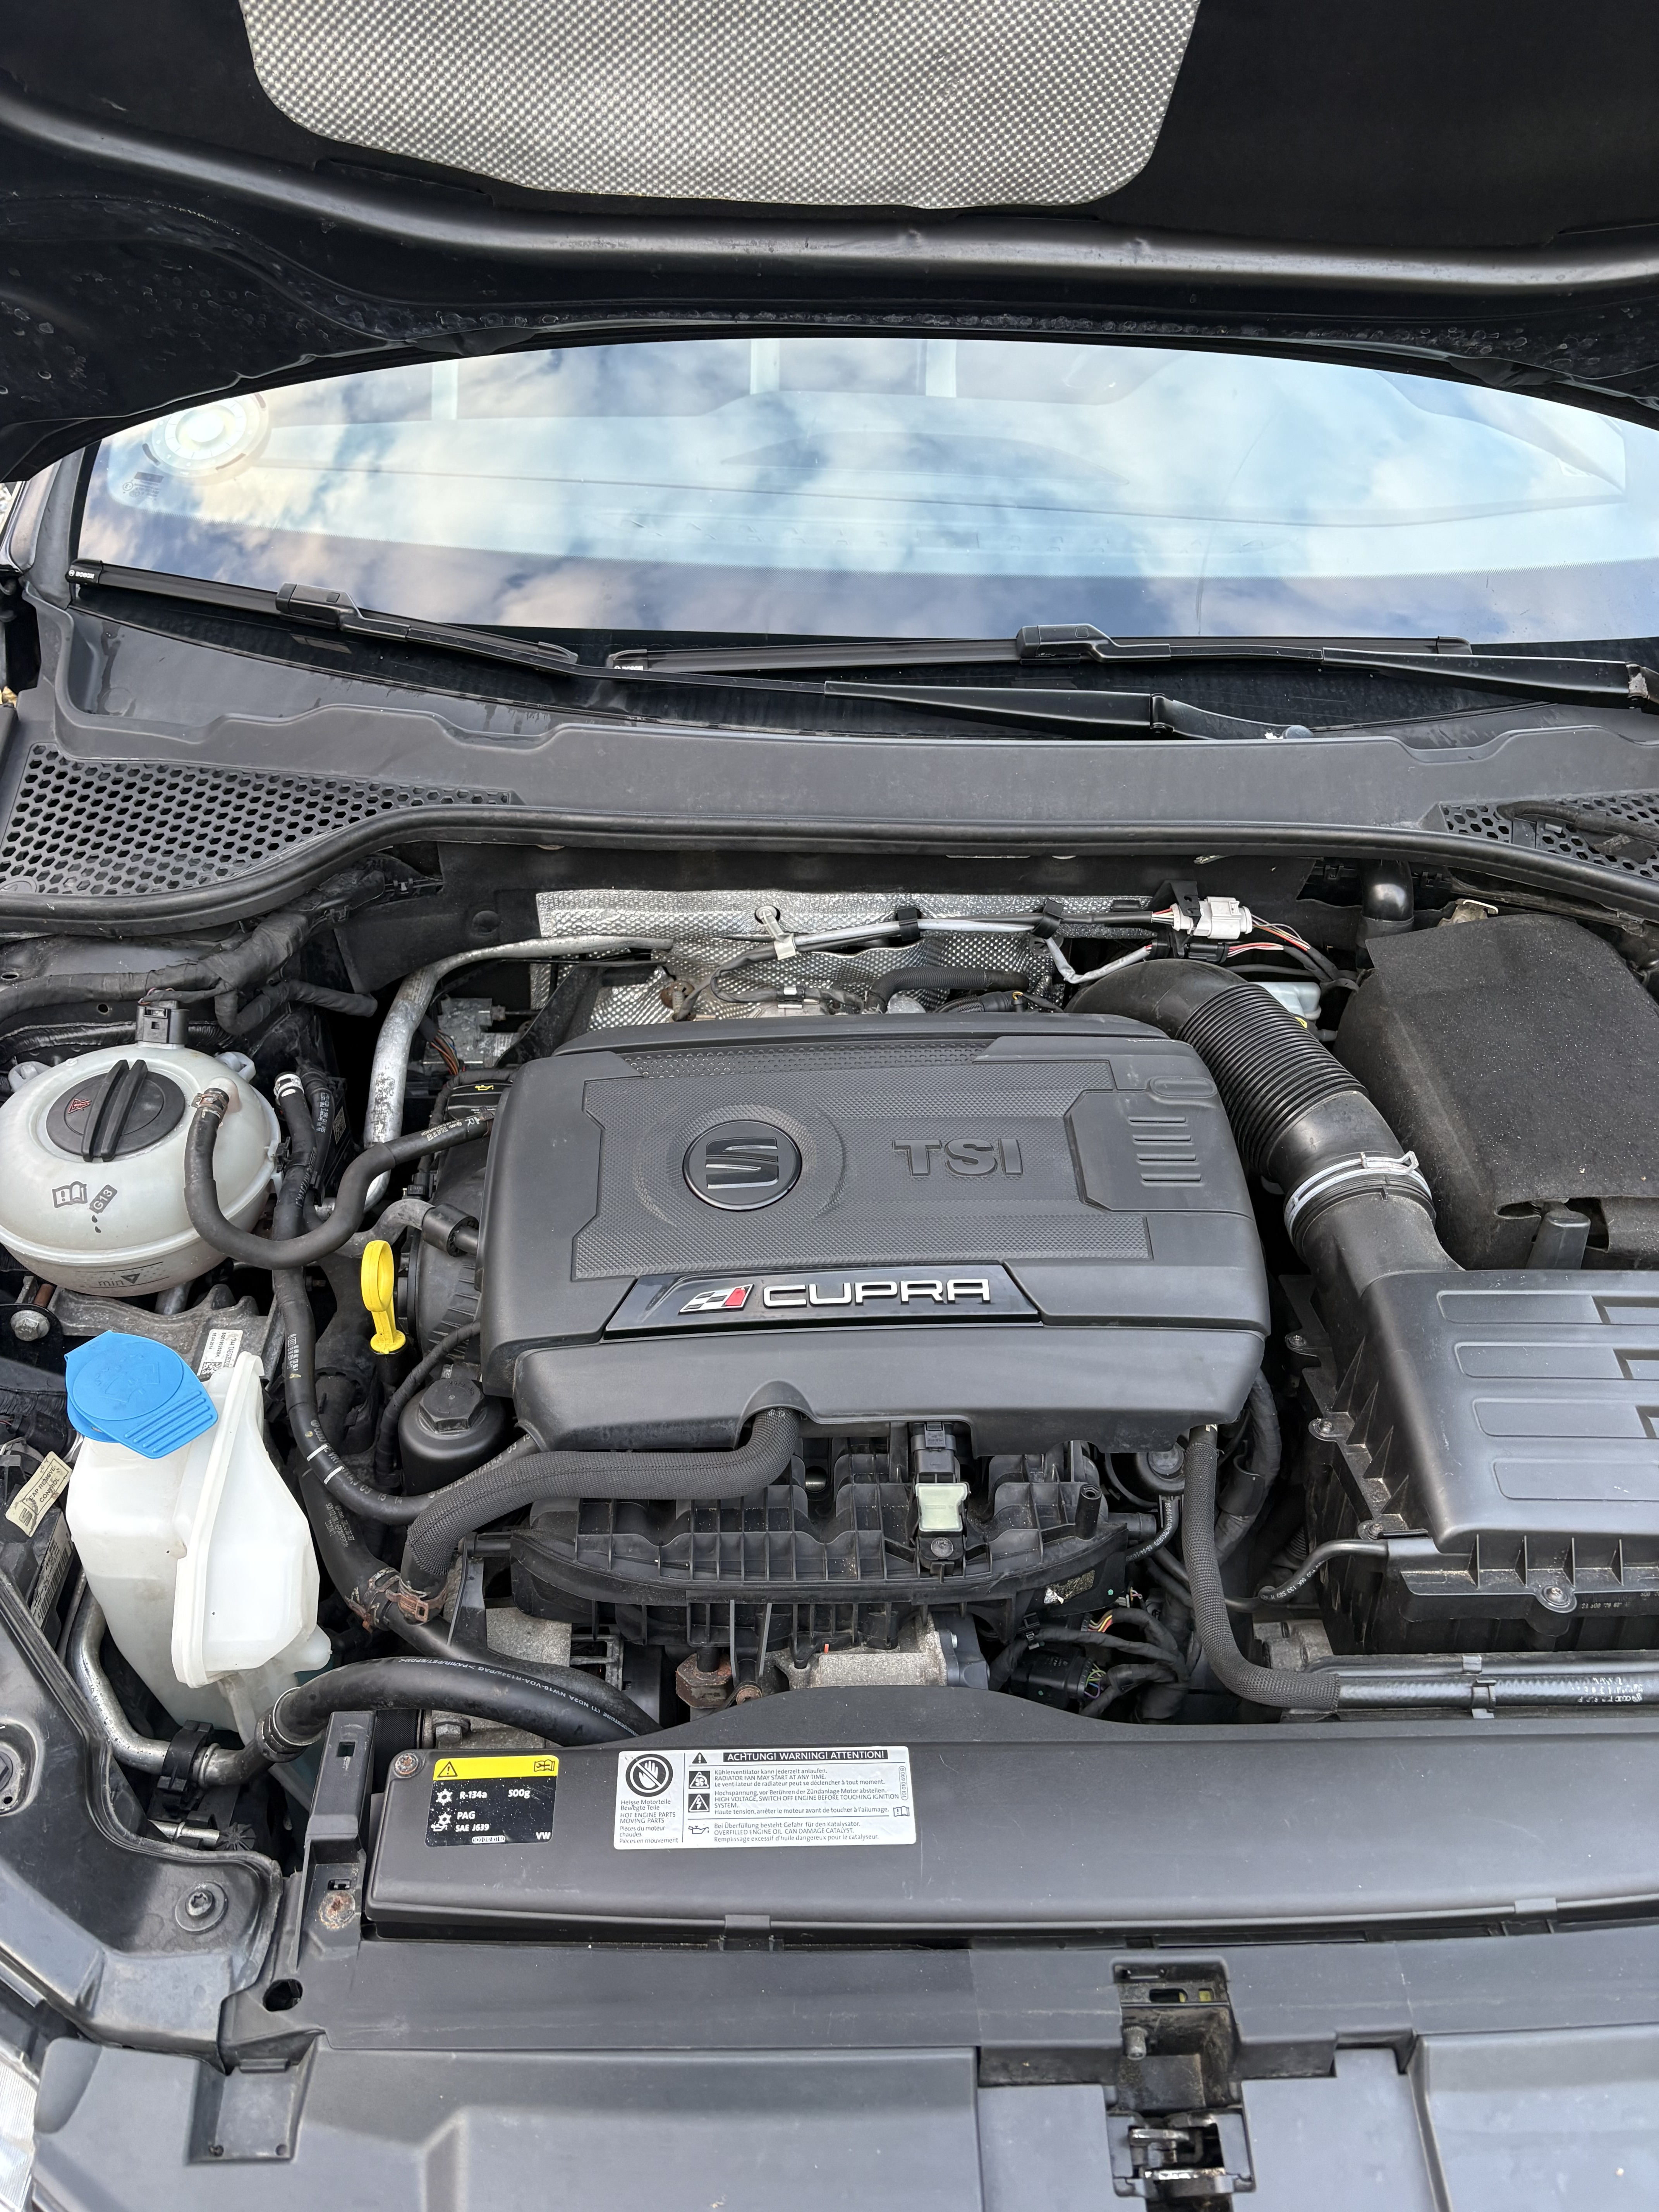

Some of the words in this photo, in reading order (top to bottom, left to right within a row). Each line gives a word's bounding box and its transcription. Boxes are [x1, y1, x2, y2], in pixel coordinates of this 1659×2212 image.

[892, 1137, 1023, 1177] TSI
[93, 1189, 113, 1210] G13
[764, 1278, 991, 1307] CUPRA
[29, 1487, 40, 1501] CAP
[40, 1478, 60, 1503] CONTROL
[569, 1695, 589, 1708] ND2A
[727, 1752, 776, 1761] ACHTUNG!
[780, 1752, 828, 1760] WARNING!
[830, 1751, 884, 1759] ATTENTION!
[459, 1790, 487, 1799] R-134a
[508, 1789, 530, 1799] 500g
[457, 1811, 476, 1820] PAG
[536, 1831, 551, 1840] VW
